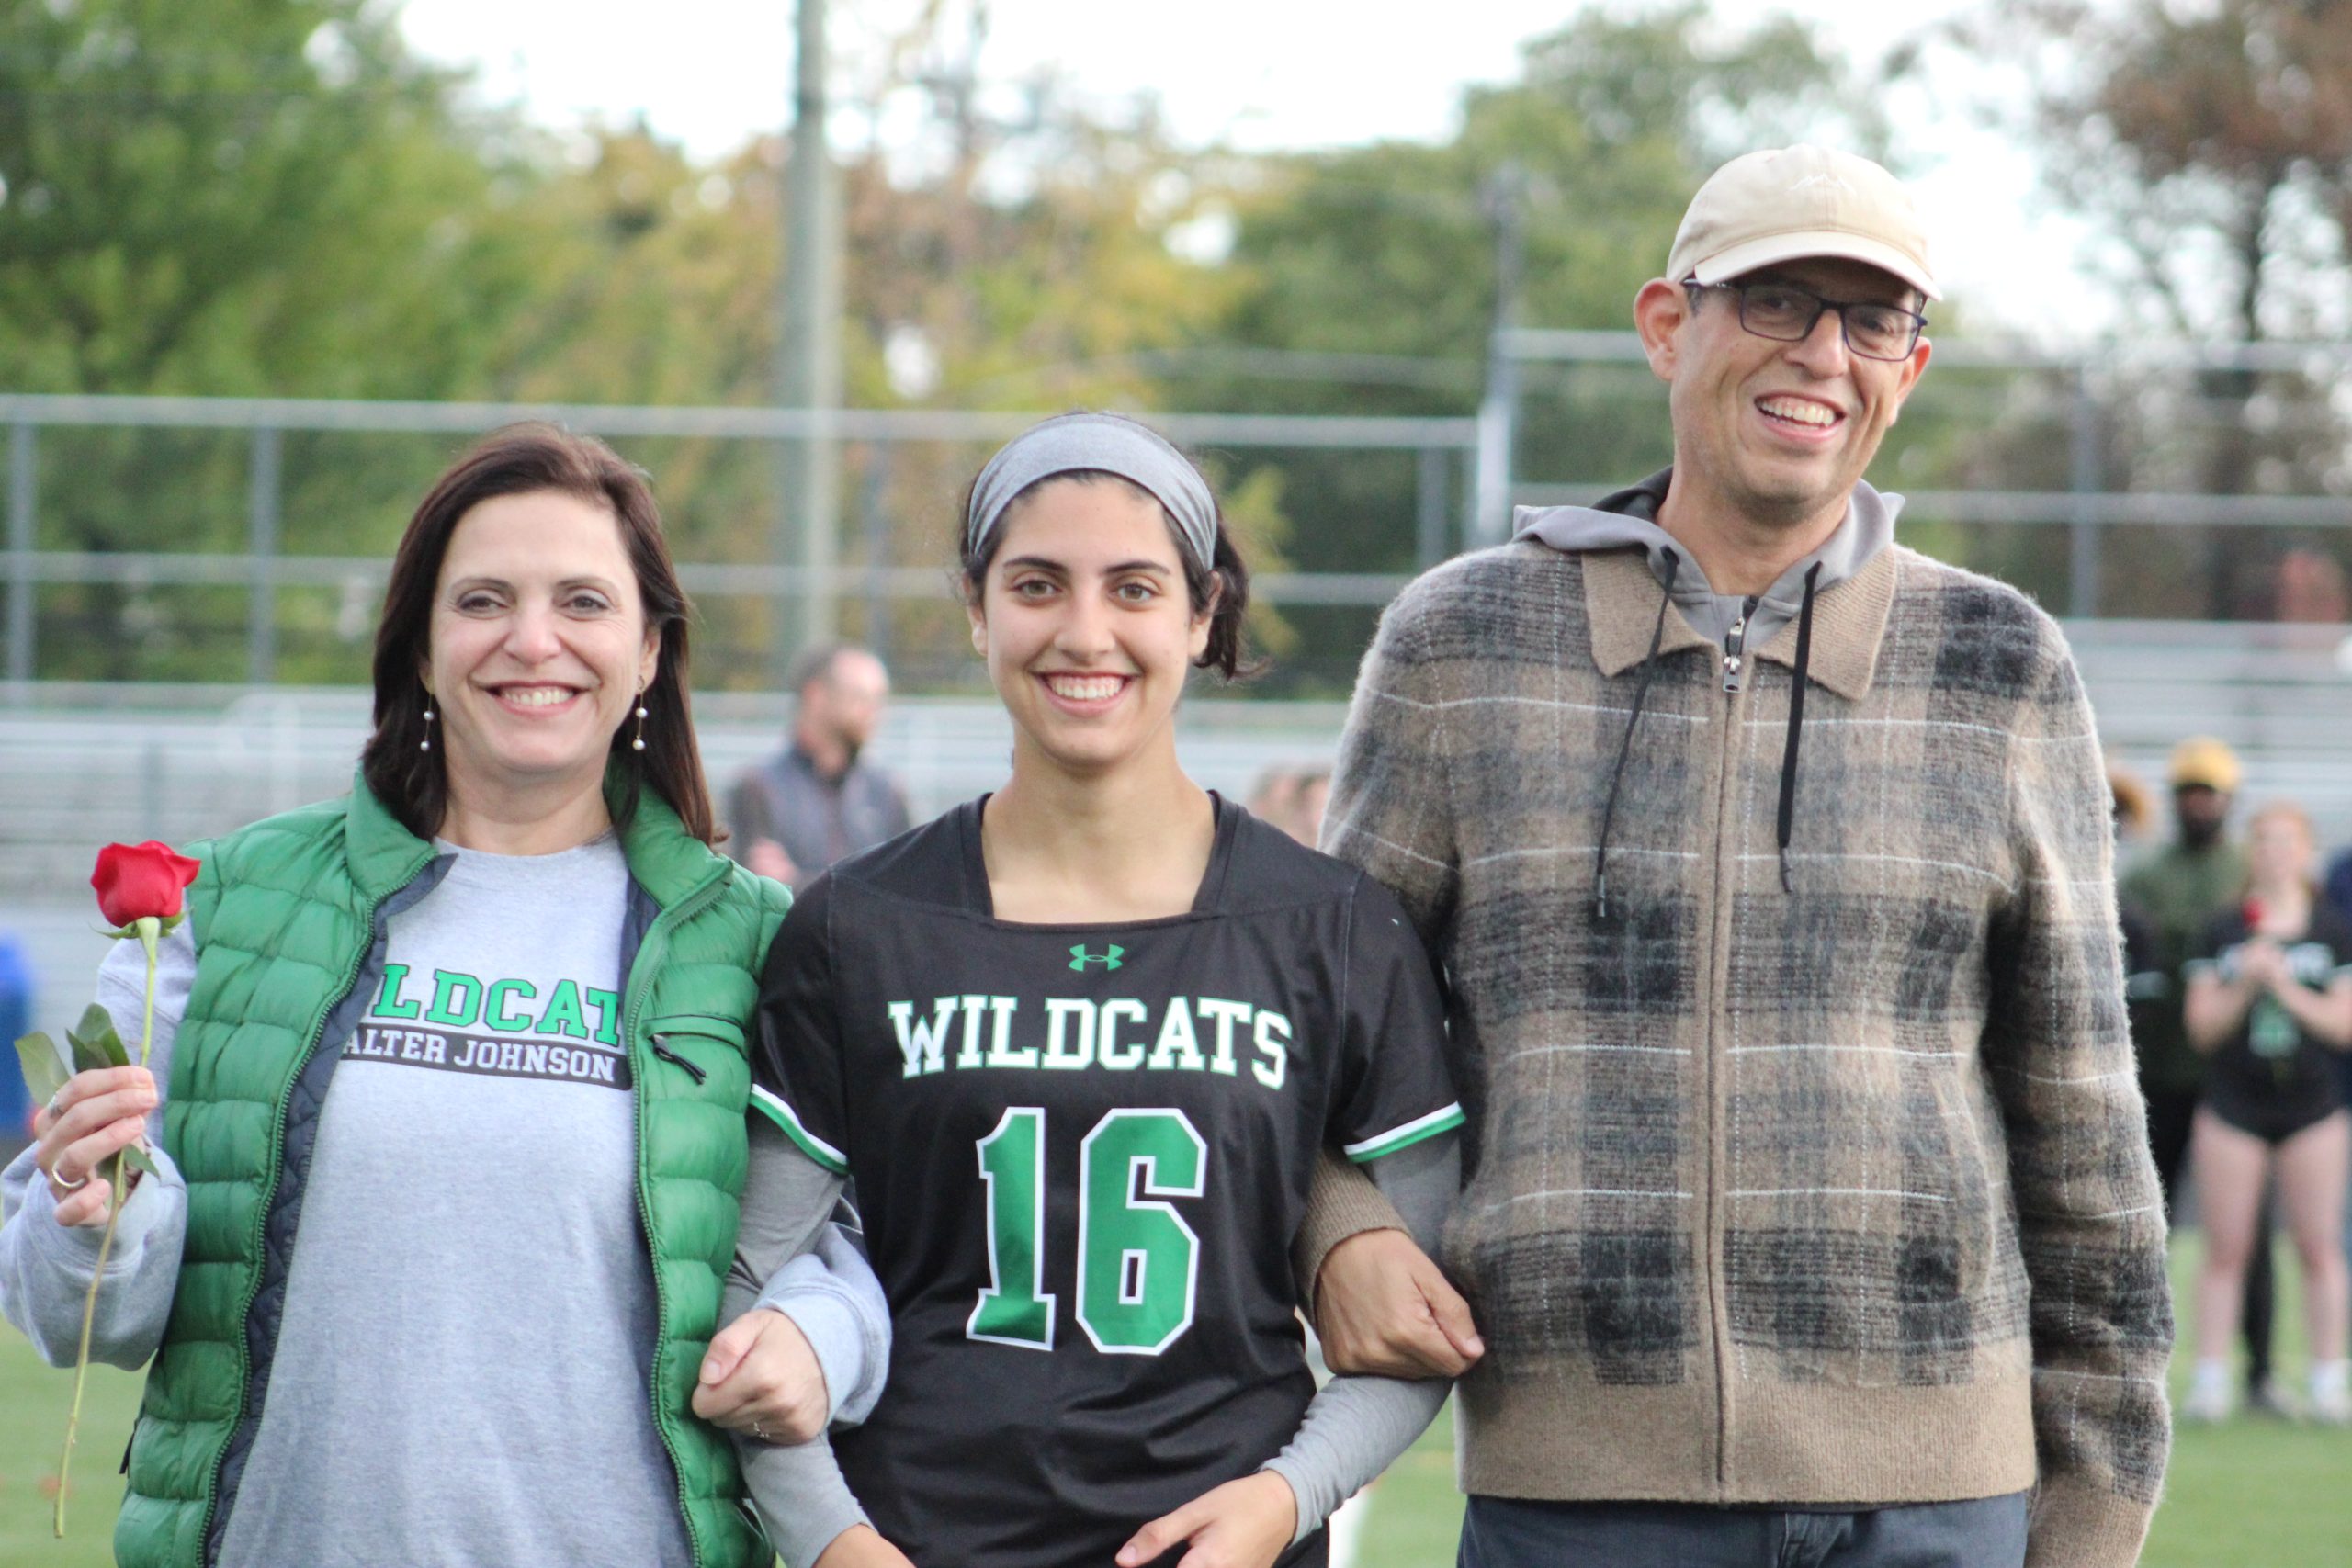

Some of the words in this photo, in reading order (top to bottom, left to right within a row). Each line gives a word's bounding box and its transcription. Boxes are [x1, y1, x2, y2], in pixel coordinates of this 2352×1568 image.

[454, 1039, 616, 1082] JOHNSON
[888, 994, 1292, 1090] WILDCATS
[966, 1106, 1207, 1356] 16
